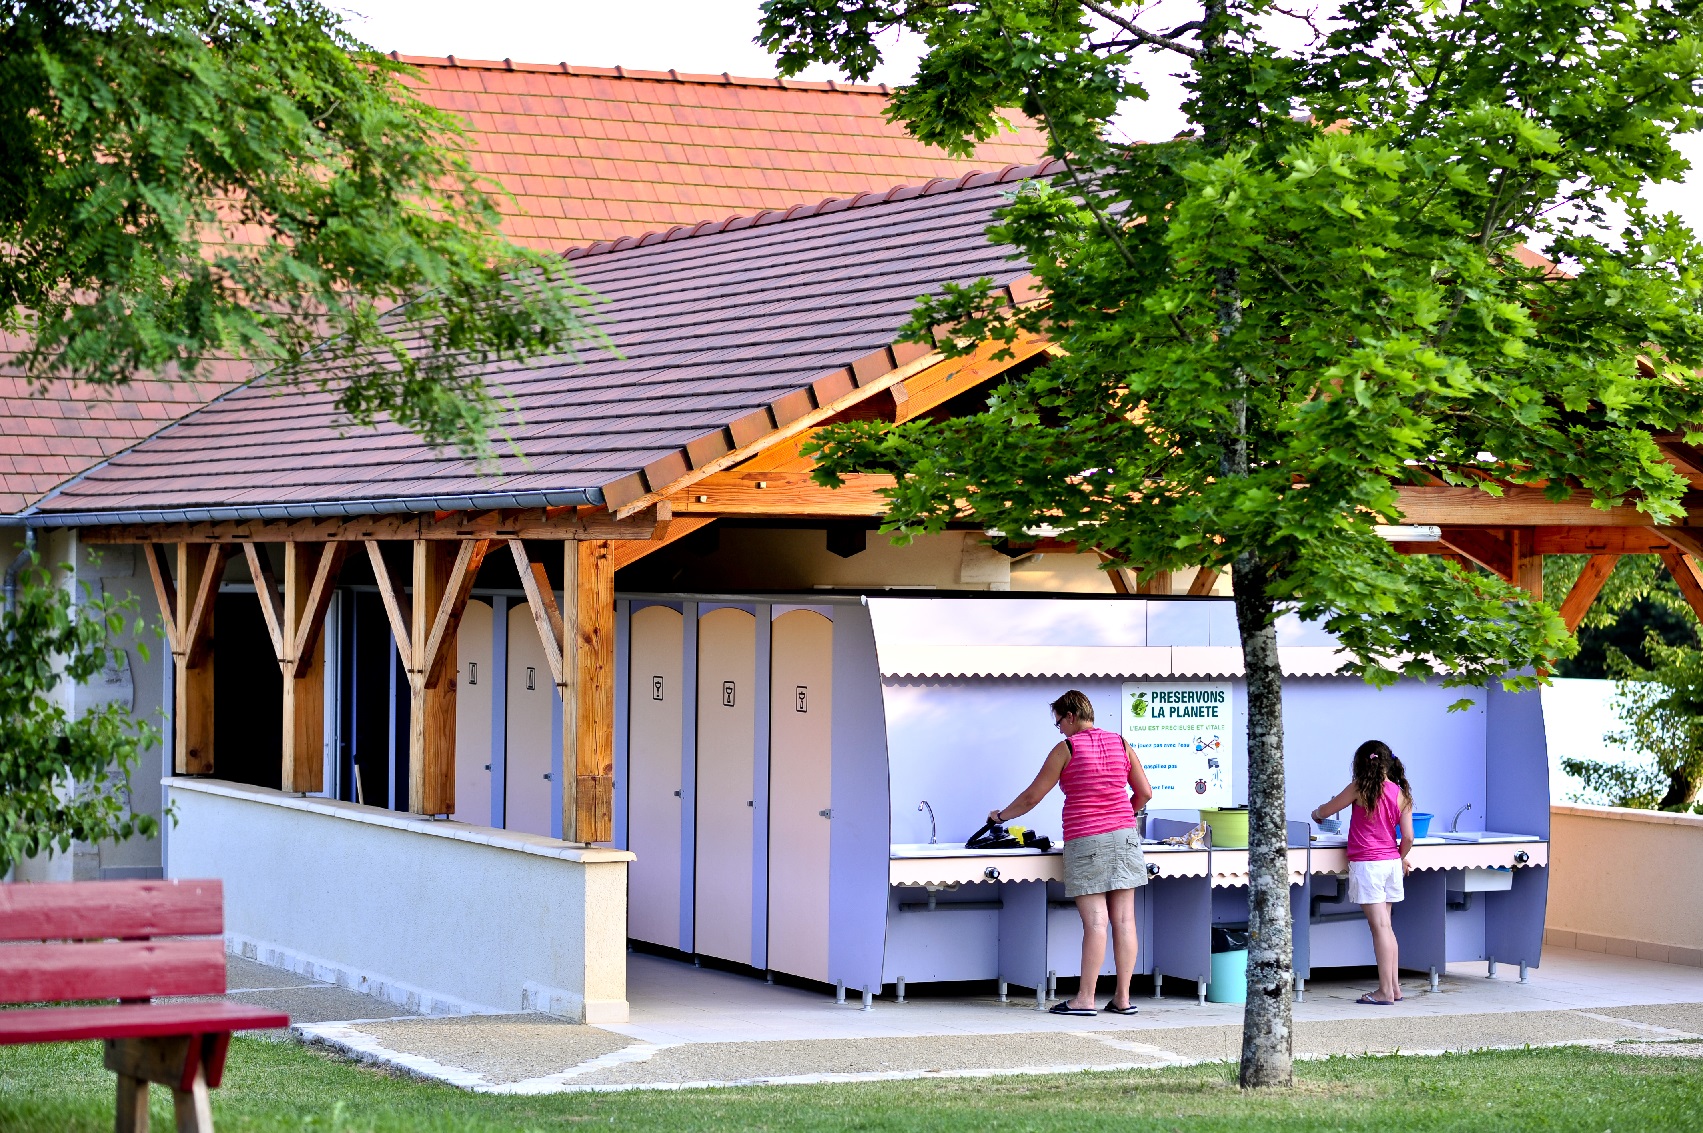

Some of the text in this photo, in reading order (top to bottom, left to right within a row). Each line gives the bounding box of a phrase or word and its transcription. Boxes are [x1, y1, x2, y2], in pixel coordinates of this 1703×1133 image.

[1151, 690, 1225, 704] PRESERVONS
[1151, 706, 1219, 719] LA PLANETE
